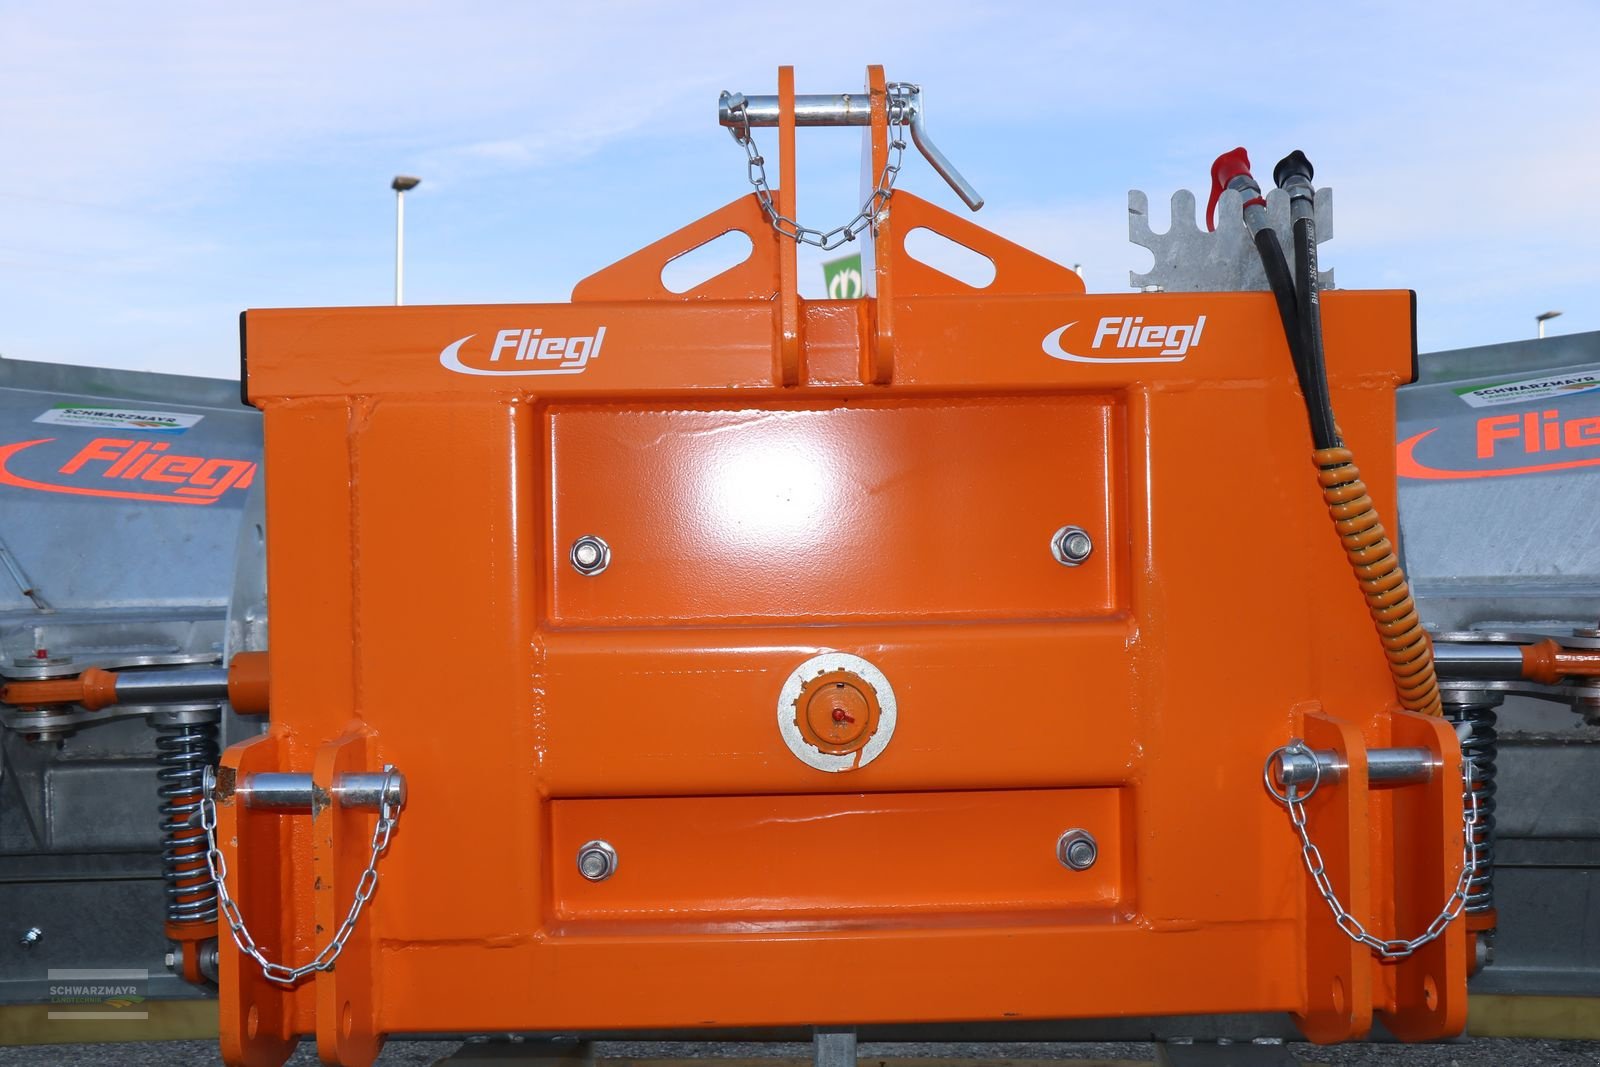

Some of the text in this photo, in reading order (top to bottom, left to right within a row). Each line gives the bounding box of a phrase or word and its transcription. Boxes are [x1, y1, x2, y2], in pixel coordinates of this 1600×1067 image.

[490, 326, 607, 368] Fliegl
[1092, 315, 1207, 356] Fliegl
[1473, 376, 1595, 397] SCHWARZMAYR
[63, 408, 177, 423] SCHWARZMAYR
